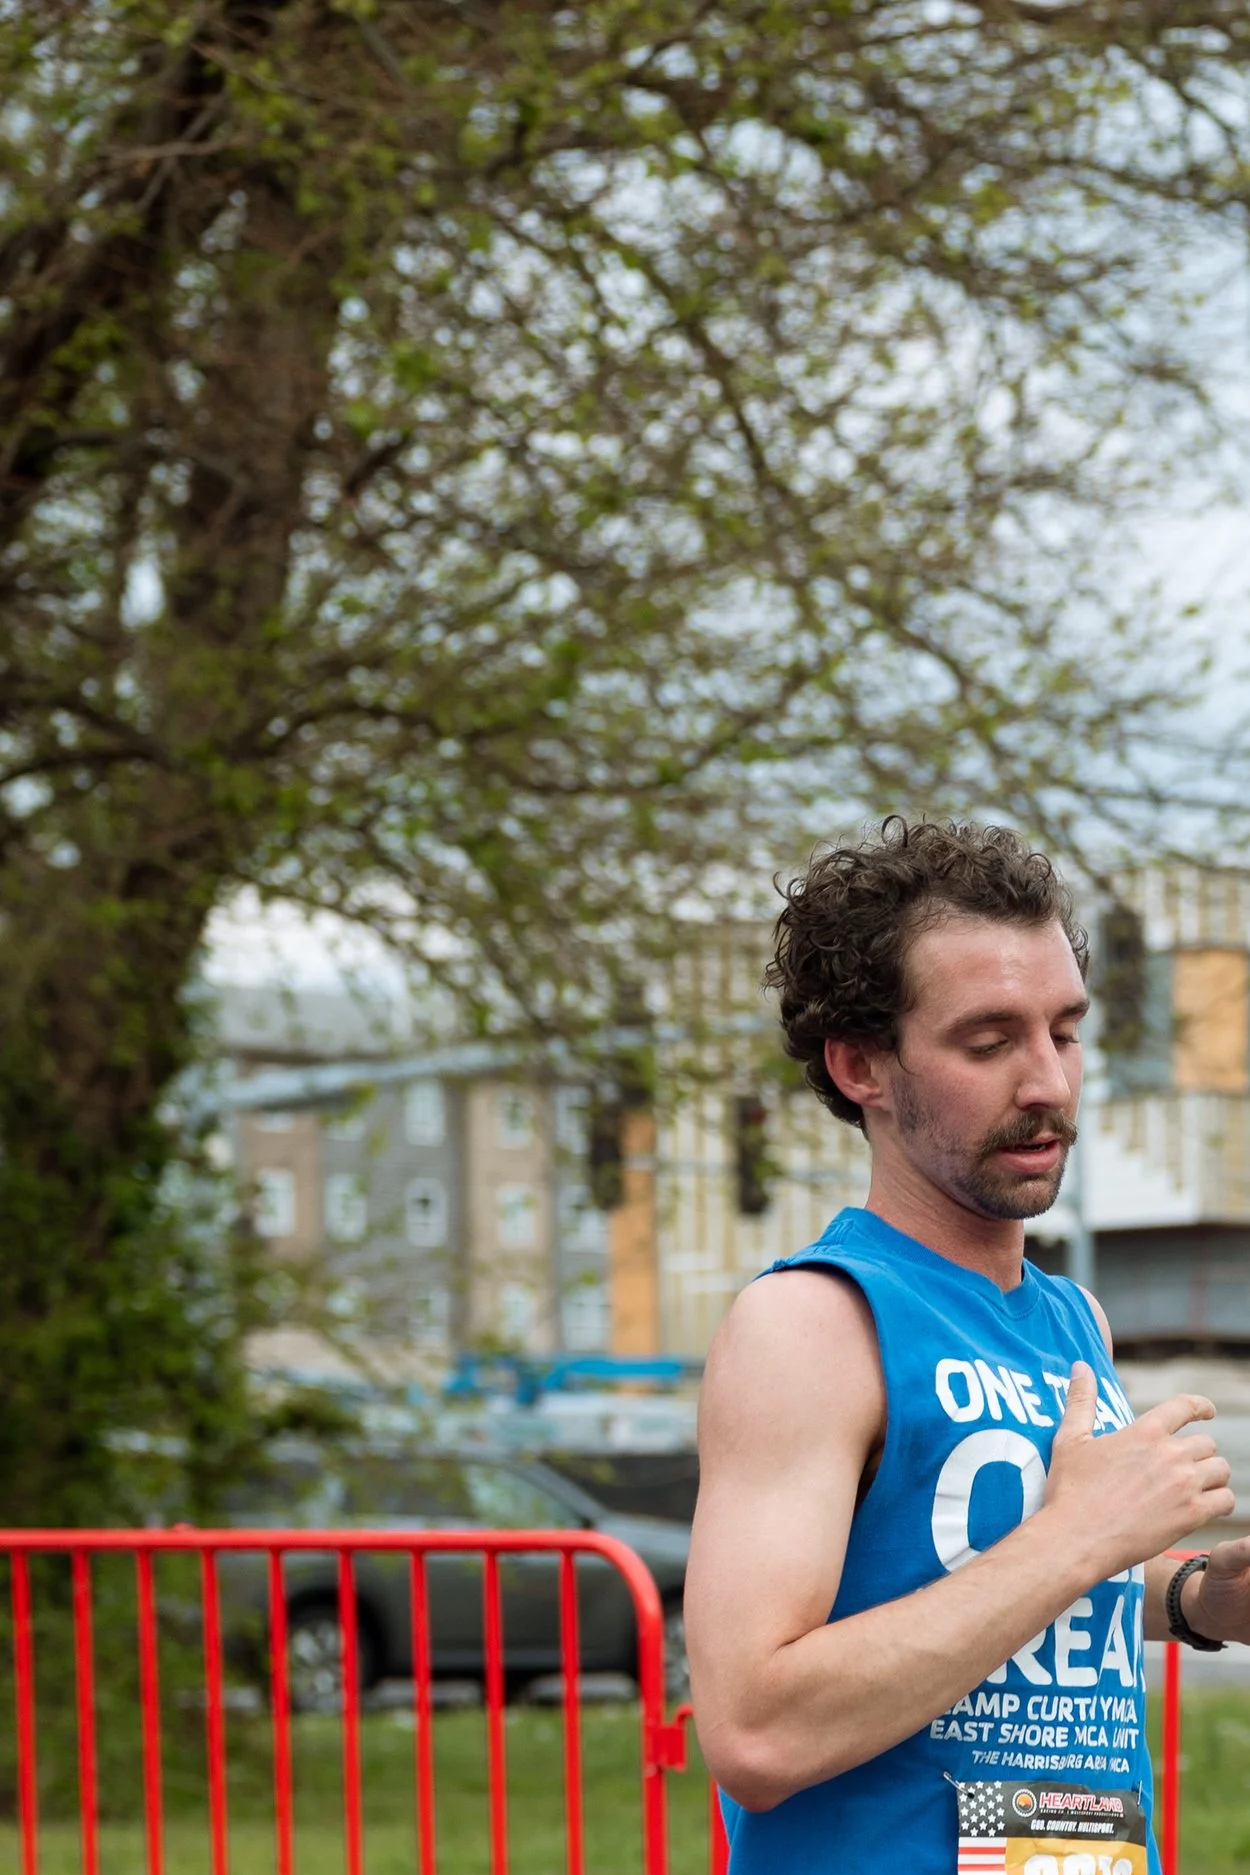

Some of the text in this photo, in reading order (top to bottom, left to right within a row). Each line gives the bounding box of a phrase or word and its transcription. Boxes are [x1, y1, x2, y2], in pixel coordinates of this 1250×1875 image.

[936, 1359, 1054, 1427] ONE
[943, 1692, 1020, 1718] AMP
[930, 1719, 994, 1742] EAST
[998, 1724, 1069, 1748] SHORE
[972, 1750, 1000, 1765] THE
[1039, 1791, 1124, 1812] HEARTLAND
